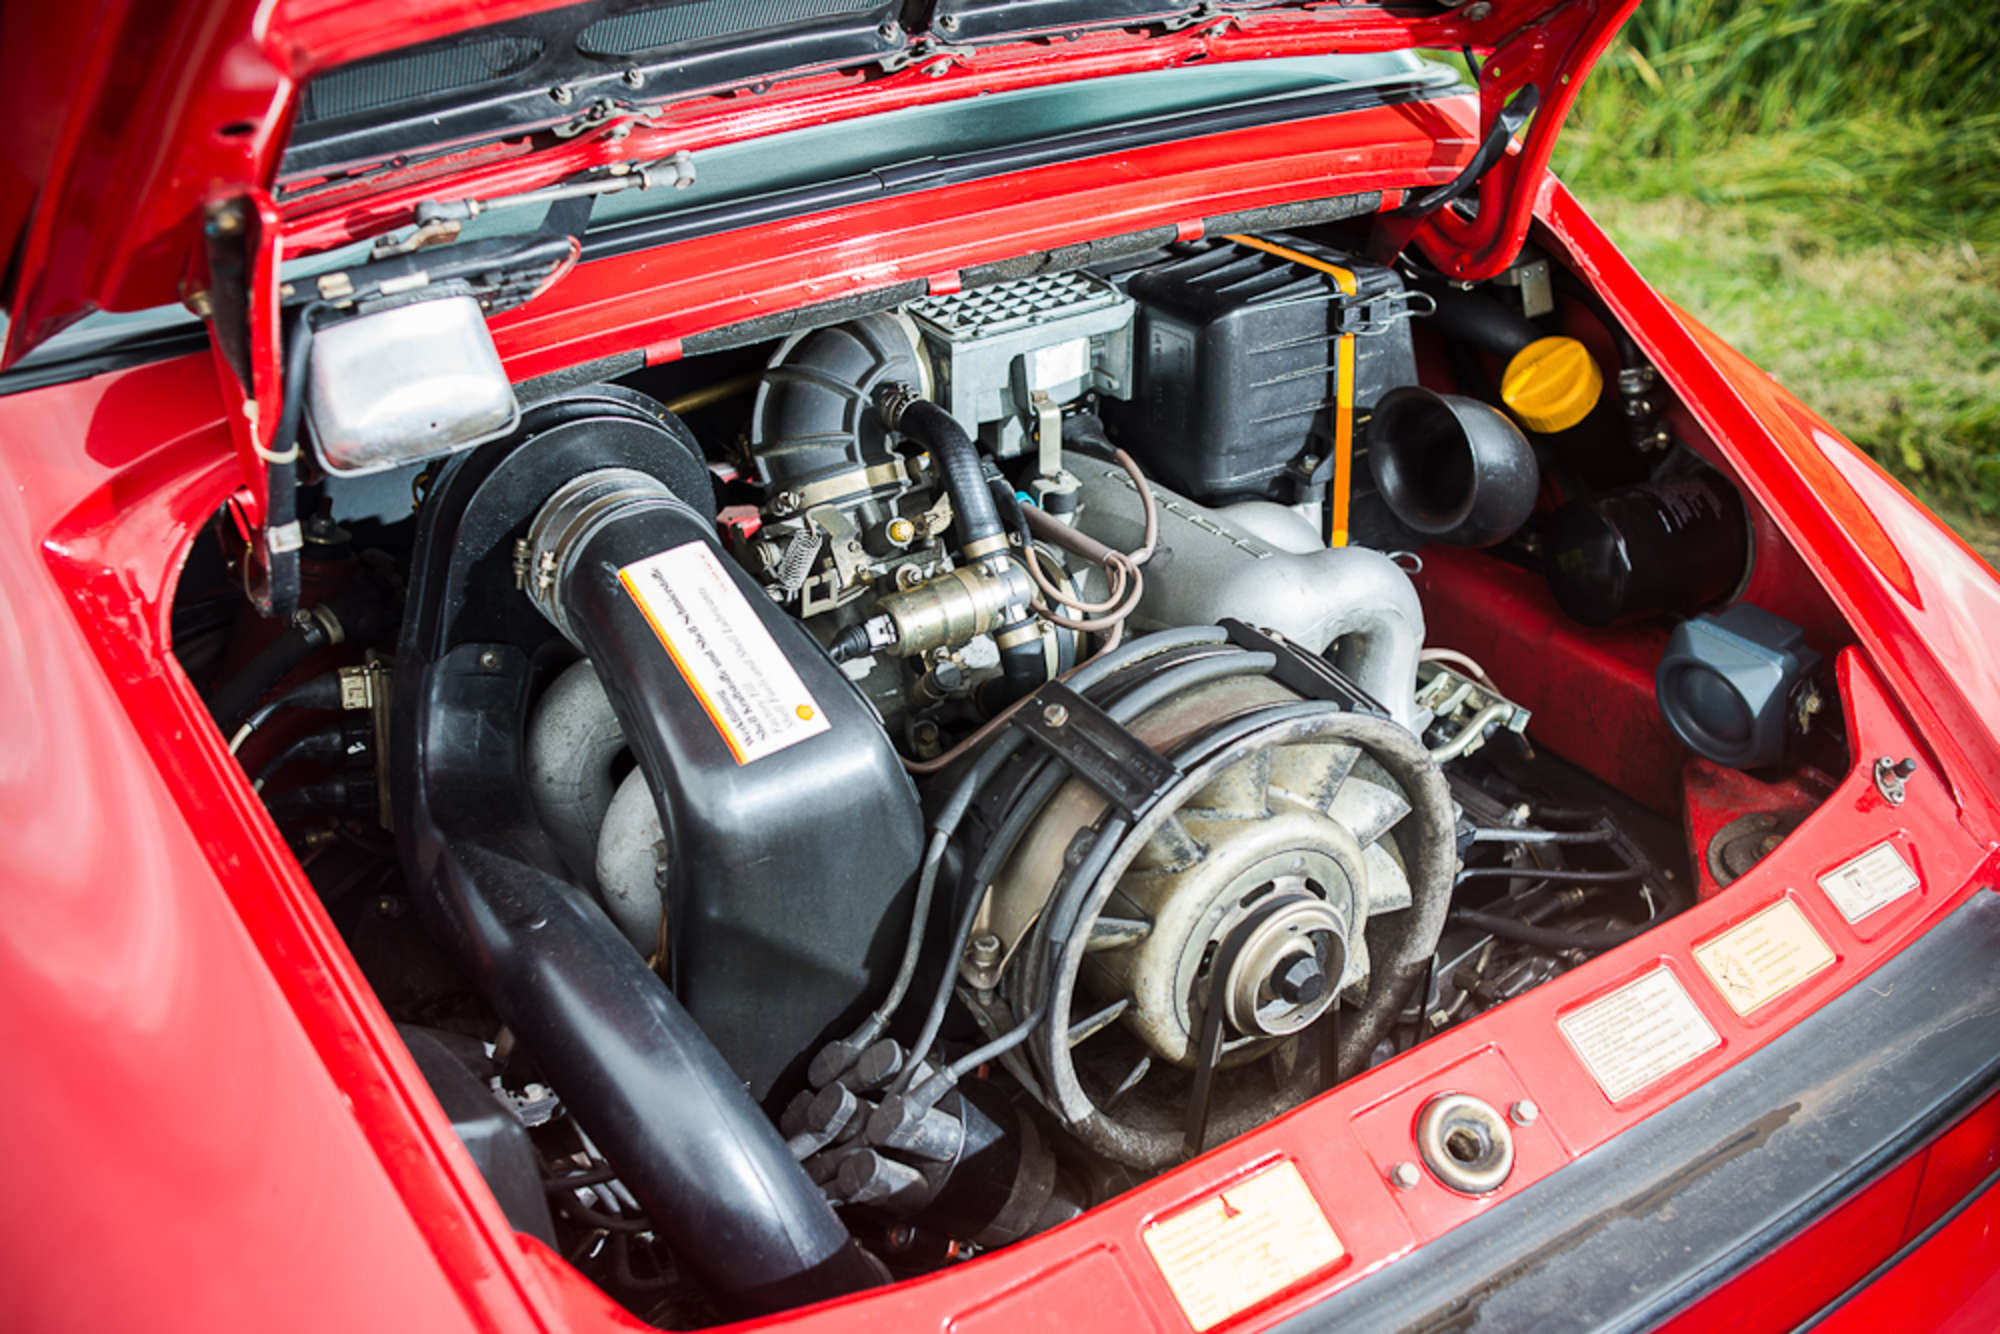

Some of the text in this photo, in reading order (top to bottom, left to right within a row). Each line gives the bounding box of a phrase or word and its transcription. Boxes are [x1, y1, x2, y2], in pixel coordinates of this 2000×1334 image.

[686, 624, 709, 650] Shell
[703, 648, 722, 670] und
[746, 714, 768, 741] Shell
